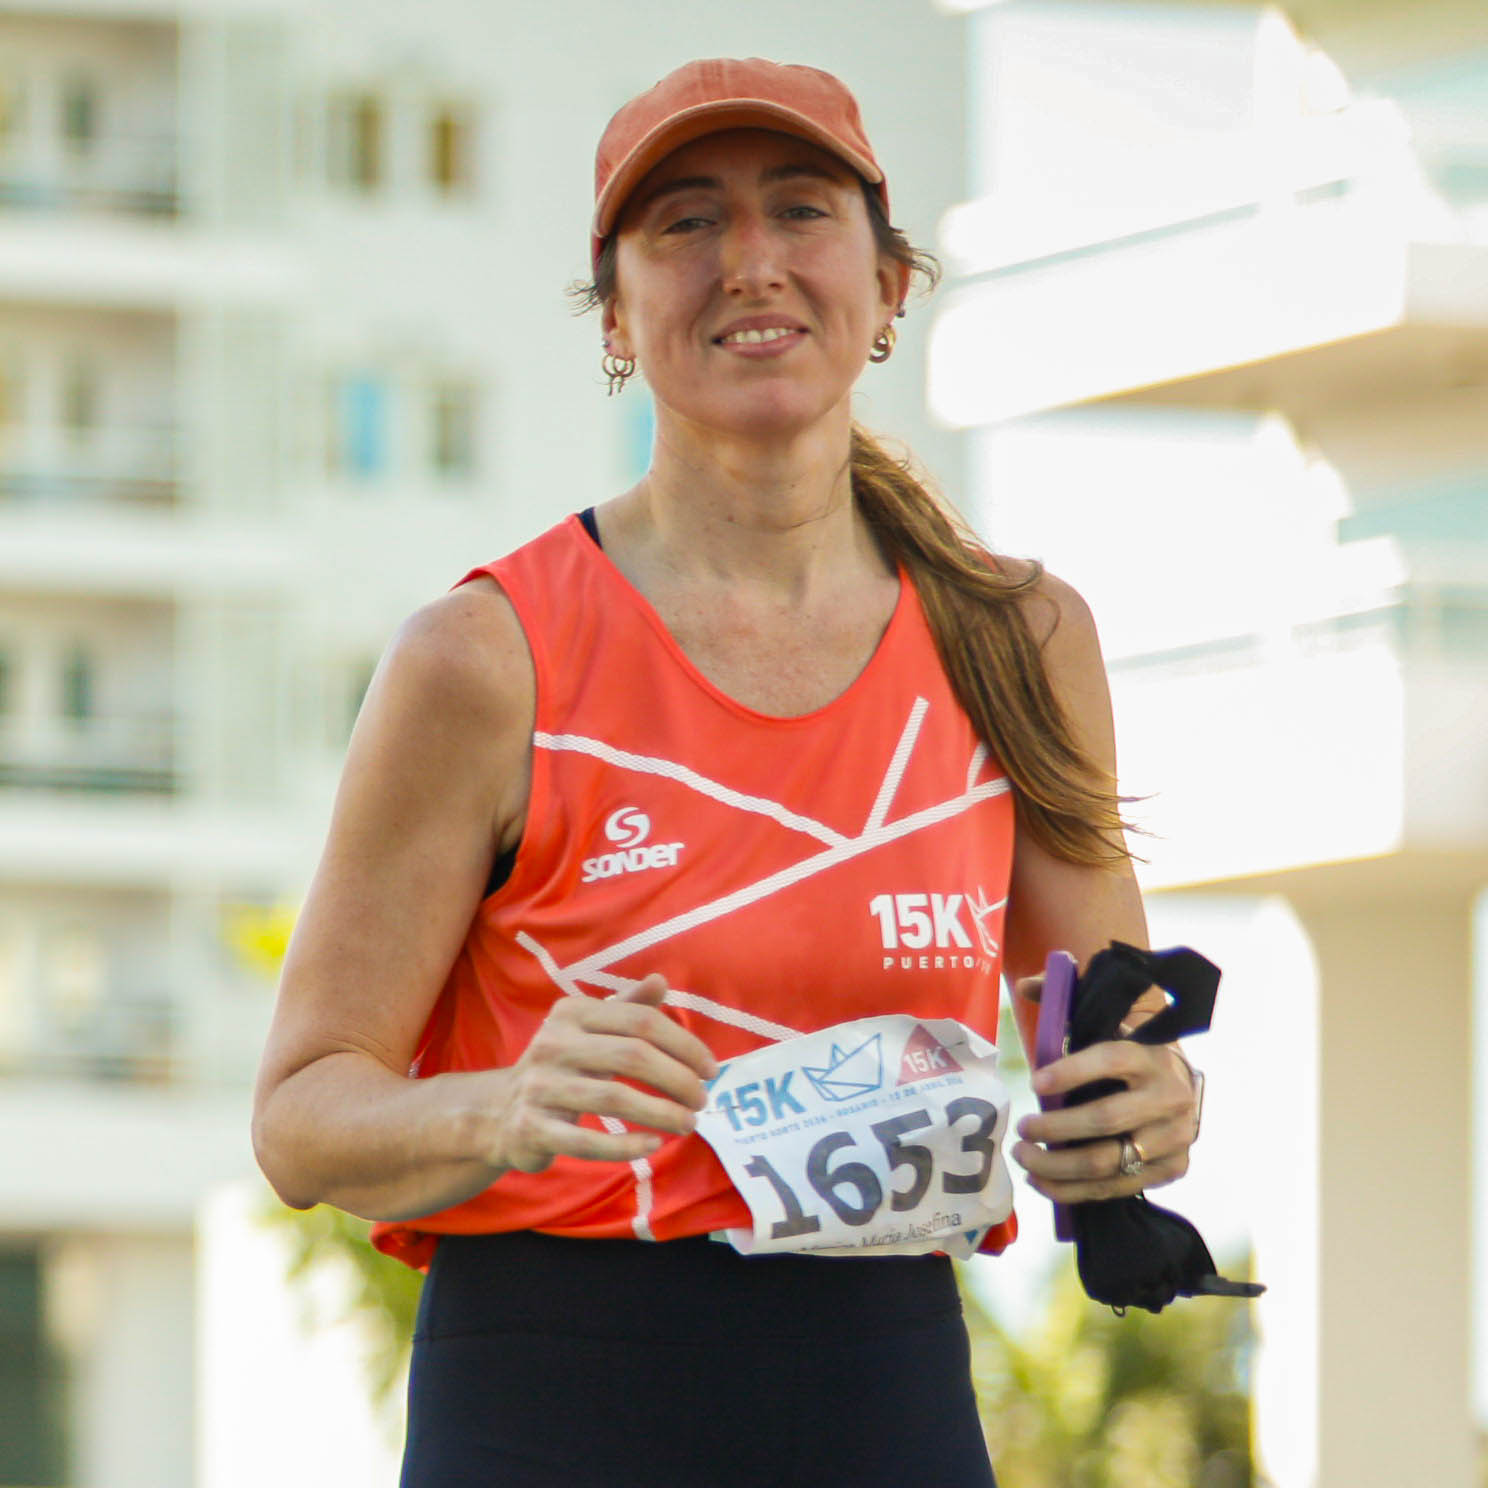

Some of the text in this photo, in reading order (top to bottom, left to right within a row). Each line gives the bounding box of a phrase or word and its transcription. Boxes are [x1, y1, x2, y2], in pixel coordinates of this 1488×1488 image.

[869, 893, 973, 949] 15K
[882, 955, 975, 970] PUERTO
[906, 1046, 951, 1073] 15K
[716, 1070, 806, 1131] 15K
[743, 1096, 998, 1239] 1653
